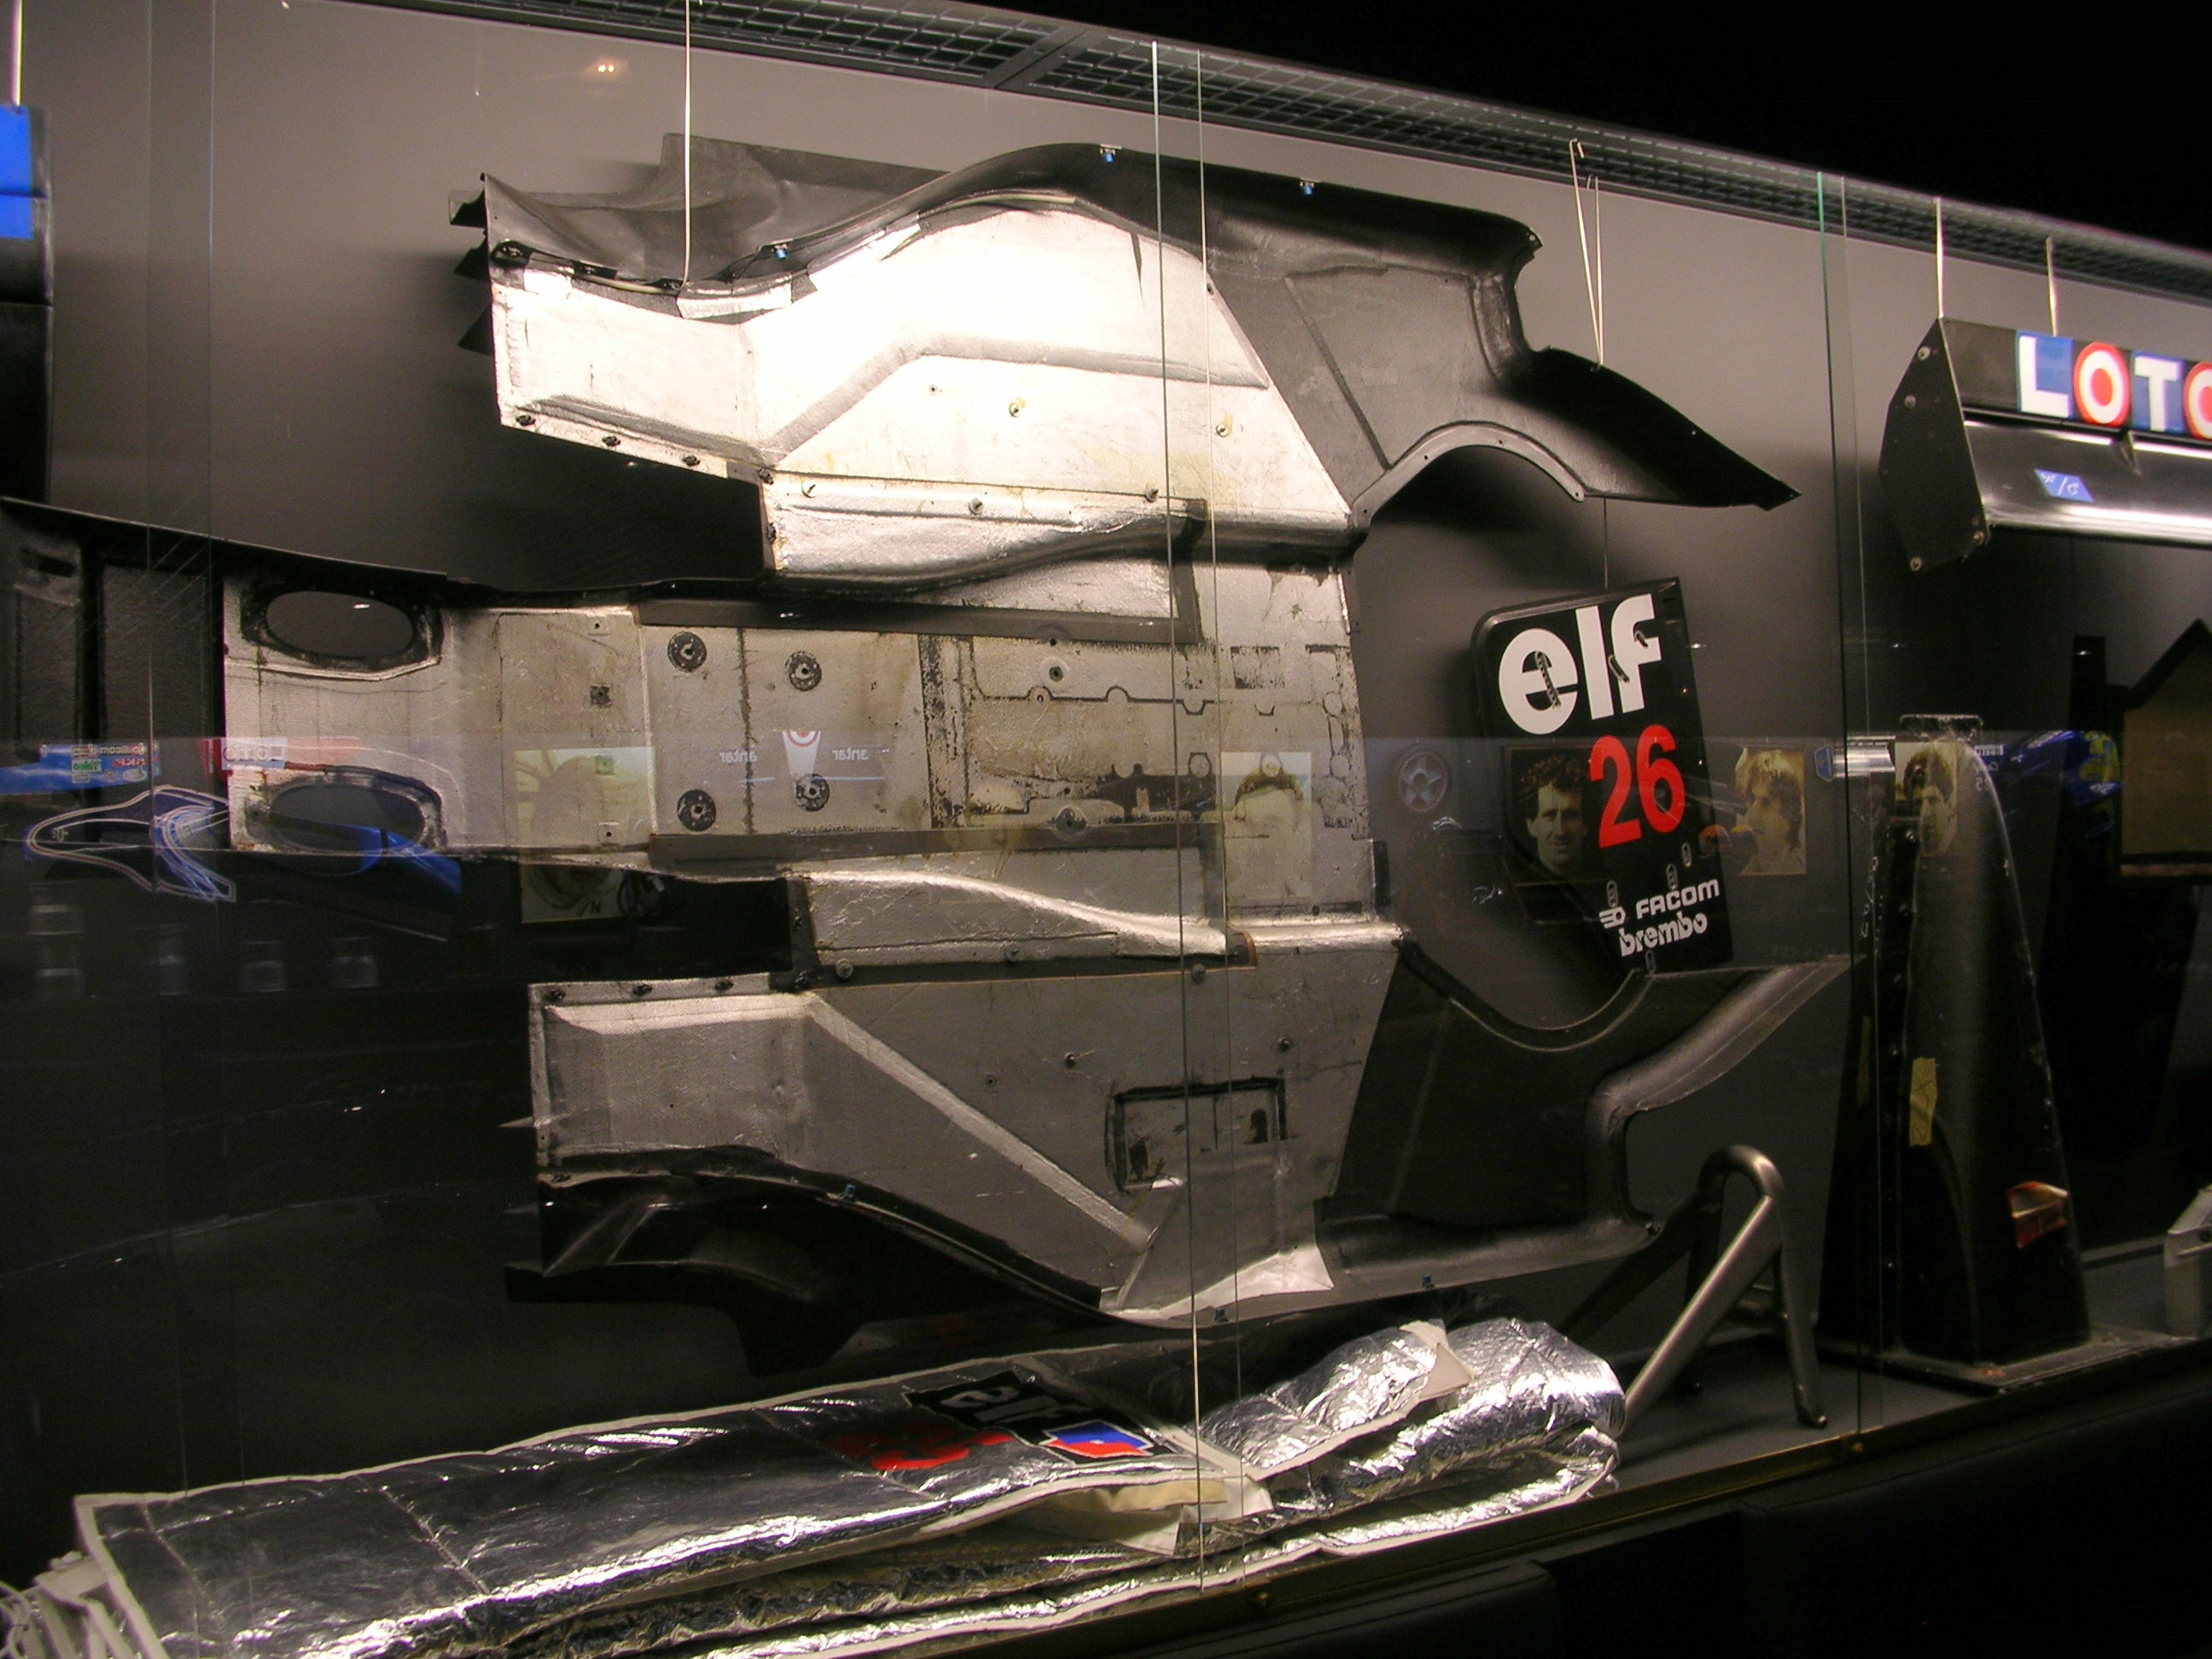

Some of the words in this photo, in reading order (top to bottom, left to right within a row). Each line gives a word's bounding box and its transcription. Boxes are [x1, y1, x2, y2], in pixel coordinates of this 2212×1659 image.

[1499, 594, 1662, 735] elf
[1589, 724, 1685, 849] 26
[1620, 911, 1708, 957] brembo
[1636, 879, 1720, 920] FACOM
